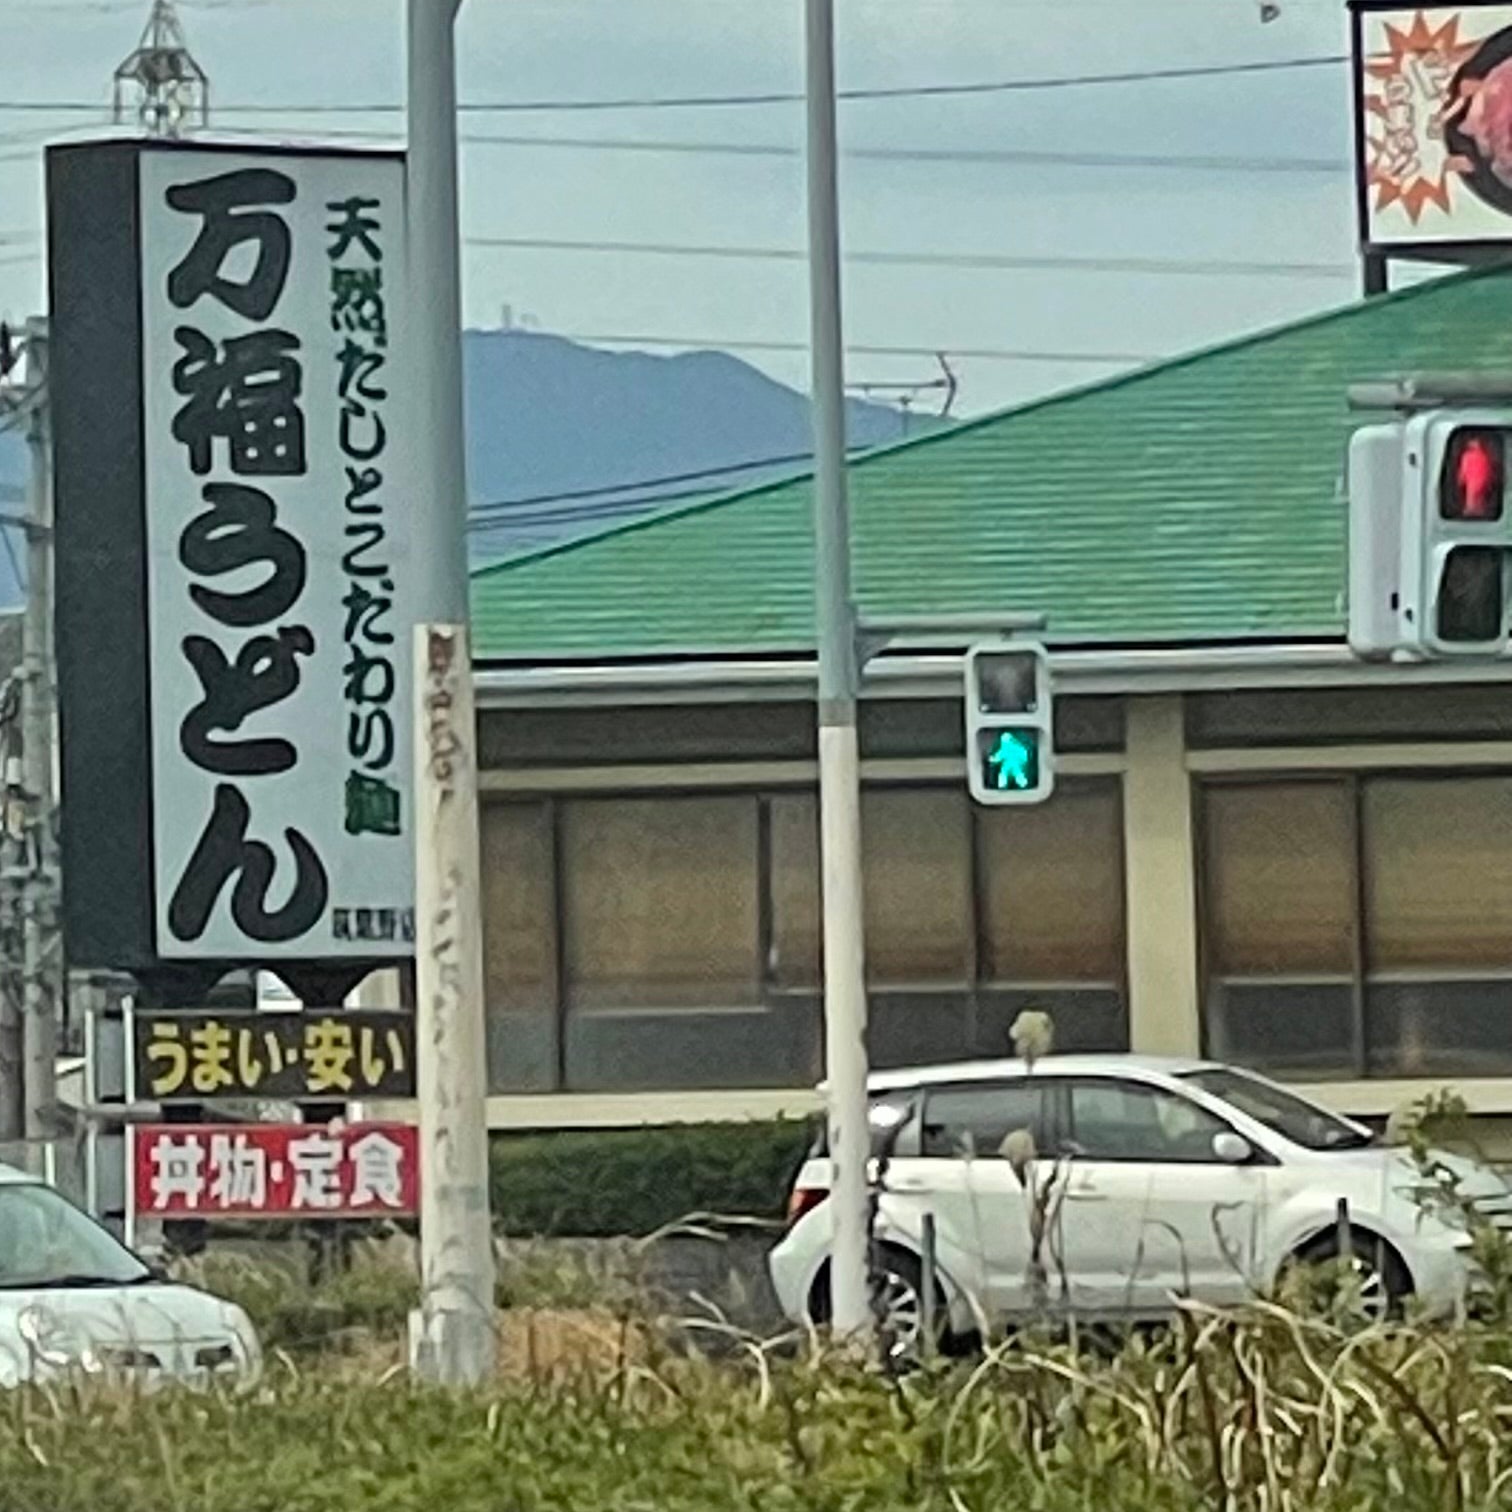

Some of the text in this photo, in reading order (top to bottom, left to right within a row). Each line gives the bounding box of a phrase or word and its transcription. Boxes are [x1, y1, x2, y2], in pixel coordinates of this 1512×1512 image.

[164, 167, 329, 943] 万福うどん
